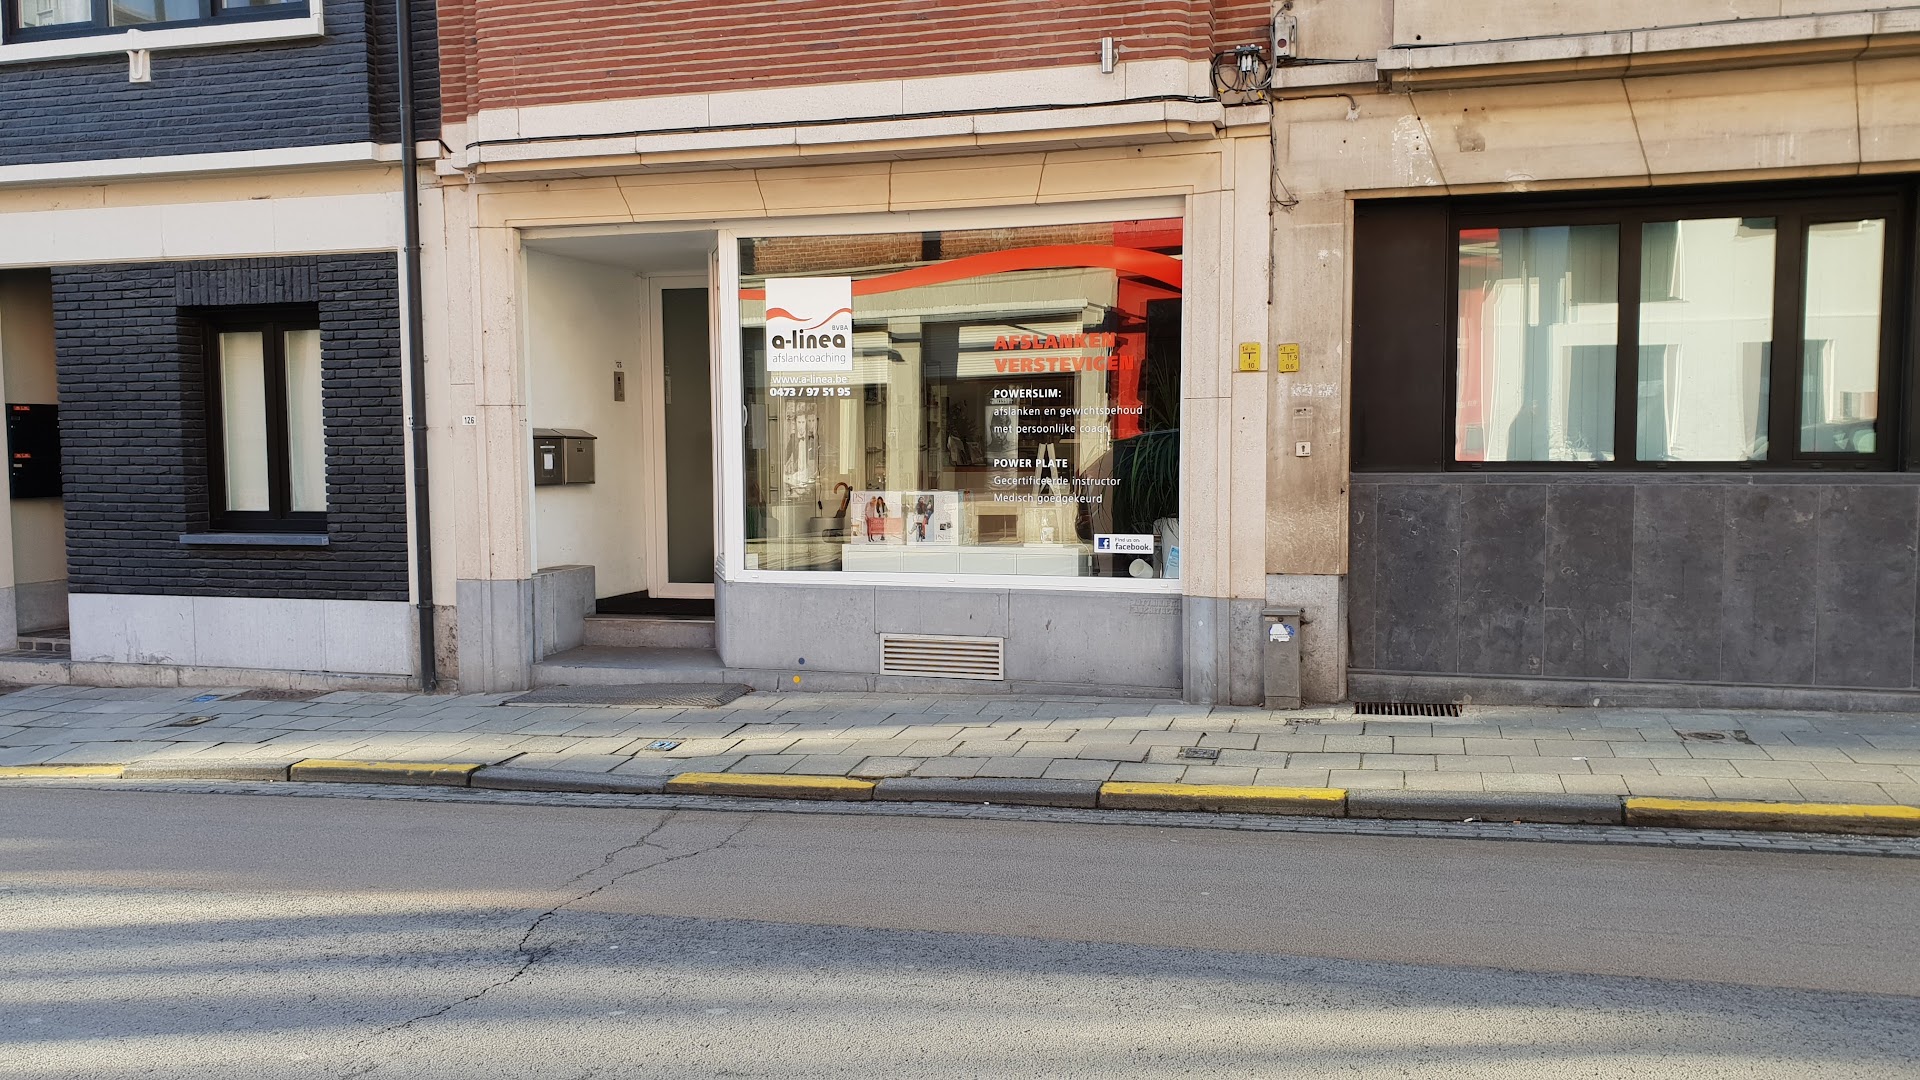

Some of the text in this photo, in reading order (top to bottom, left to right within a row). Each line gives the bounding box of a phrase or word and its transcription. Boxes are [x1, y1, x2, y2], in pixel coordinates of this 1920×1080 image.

[772, 329, 846, 349] a-linea
[994, 332, 1117, 350] AFSLANKEN
[773, 353, 846, 364] afslankcoaching
[994, 355, 1135, 373] VERSTEVIGEN
[772, 375, 848, 384] www.a-linea.be
[769, 387, 796, 397] 0473
[806, 387, 820, 397] 97
[823, 387, 834, 397] 51
[837, 387, 851, 397] 95
[993, 388, 1062, 399] POWERSLIM:
[993, 405, 1143, 417] afslanken en gewichtsbehoud
[464, 416, 475, 424] 126
[993, 424, 1109, 435] met persoonlijke coach
[993, 458, 1068, 468] POWER PLATE
[993, 475, 1121, 486] Gecertificeerde instructor
[993, 493, 1103, 505] Medisch goedgekeurd
